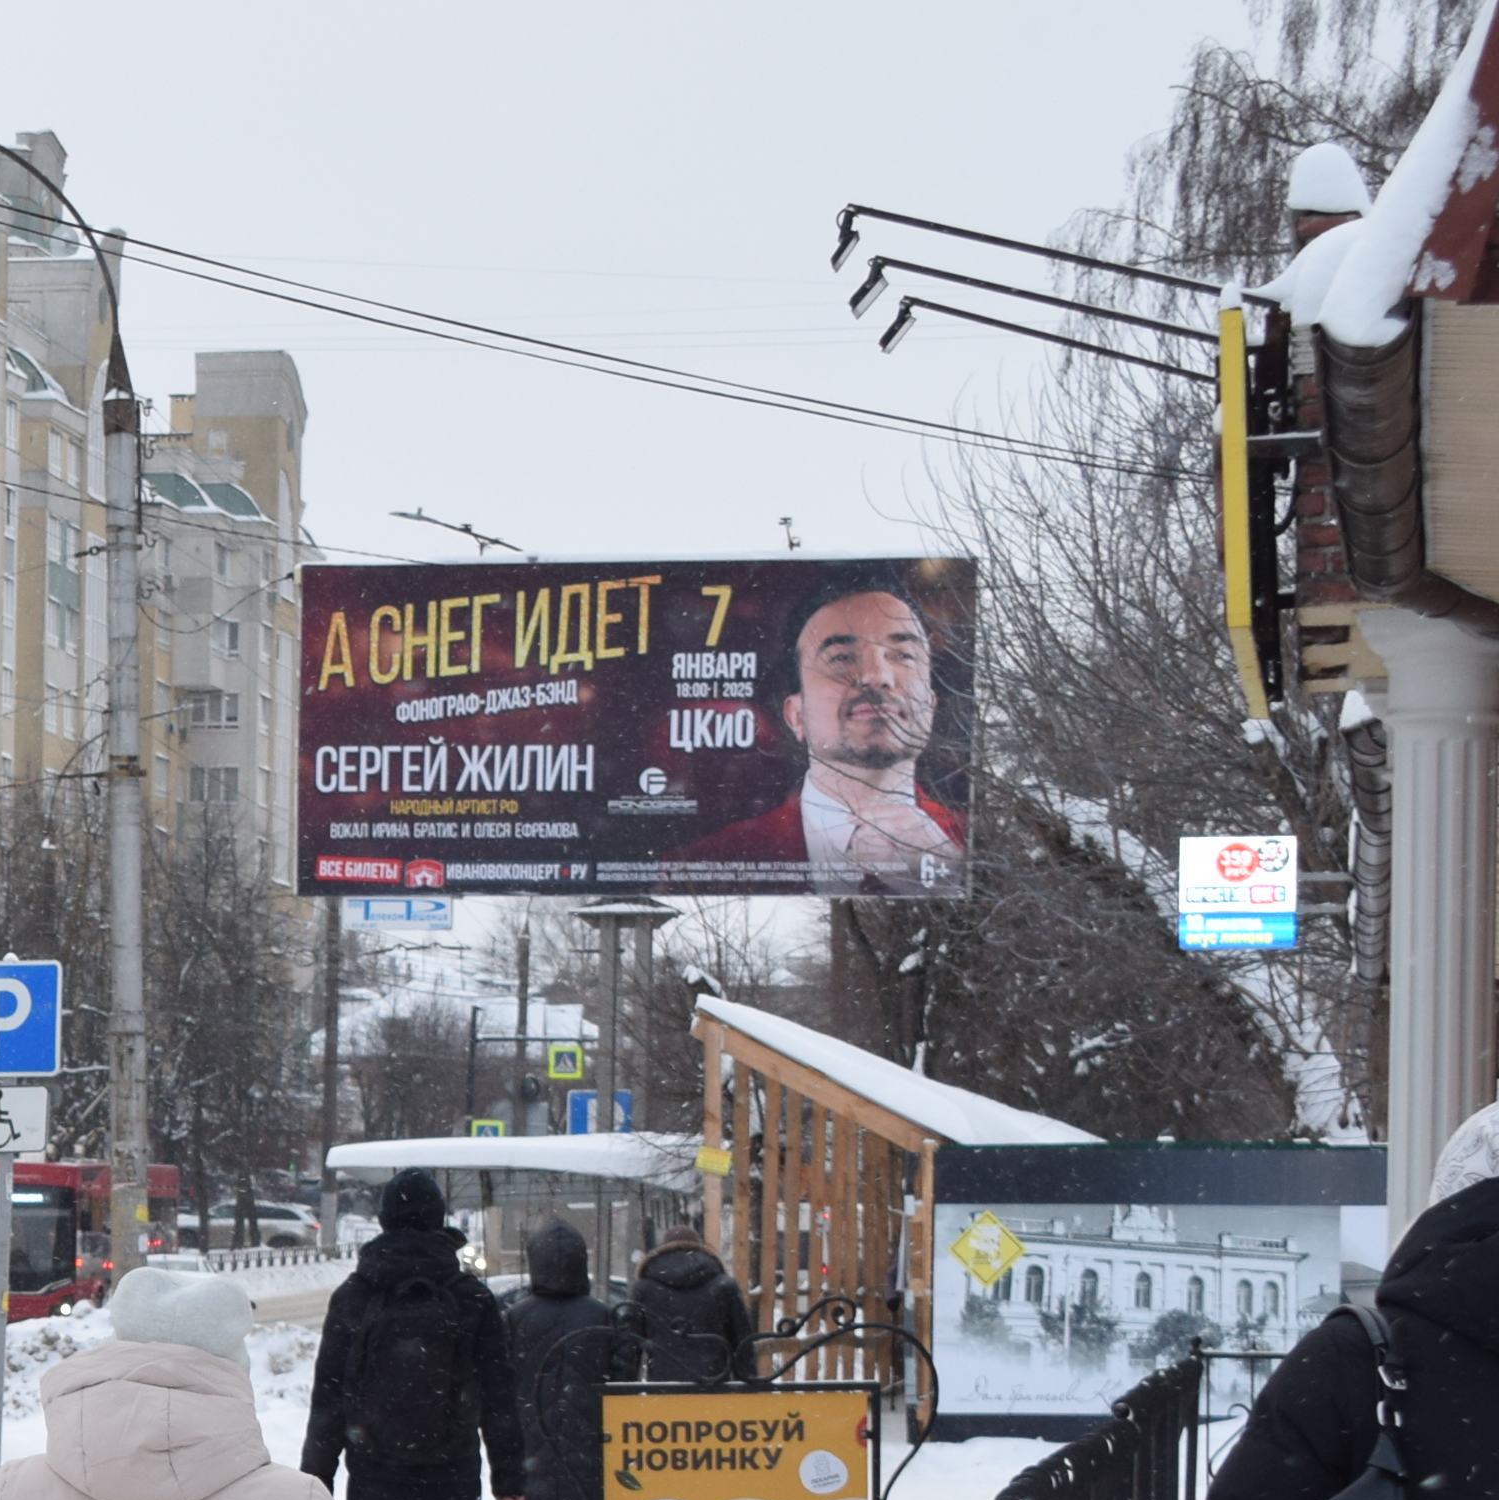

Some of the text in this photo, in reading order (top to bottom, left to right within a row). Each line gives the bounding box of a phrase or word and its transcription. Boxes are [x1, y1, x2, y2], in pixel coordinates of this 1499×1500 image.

[701, 585, 732, 646] 7
[318, 575, 663, 691] А СНЕГ ИДЕТ
[672, 652, 757, 680] ЯНВАРЯ
[395, 679, 578, 723] ФОНОГРАФ-ДЖАЗ-БЭНД
[723, 682, 753, 698] 2025
[669, 708, 755, 753] ЦКиО
[315, 736, 594, 793] СЕРГЕЙ ЖИЛИН
[390, 798, 519, 815] НАРОДНЫЙ АРТИСТ РФ
[330, 822, 579, 839] ВОКАЛ ИРИНА БРАТИС И ОЛЕСЯ ЕФРЕМОВА
[319, 860, 398, 879] ВСЕ БИЛЕТЫ
[919, 854, 950, 888] 6+
[622, 1411, 805, 1443] ПОПРОБУЙ
[622, 1447, 783, 1471] НОВИНКУ
